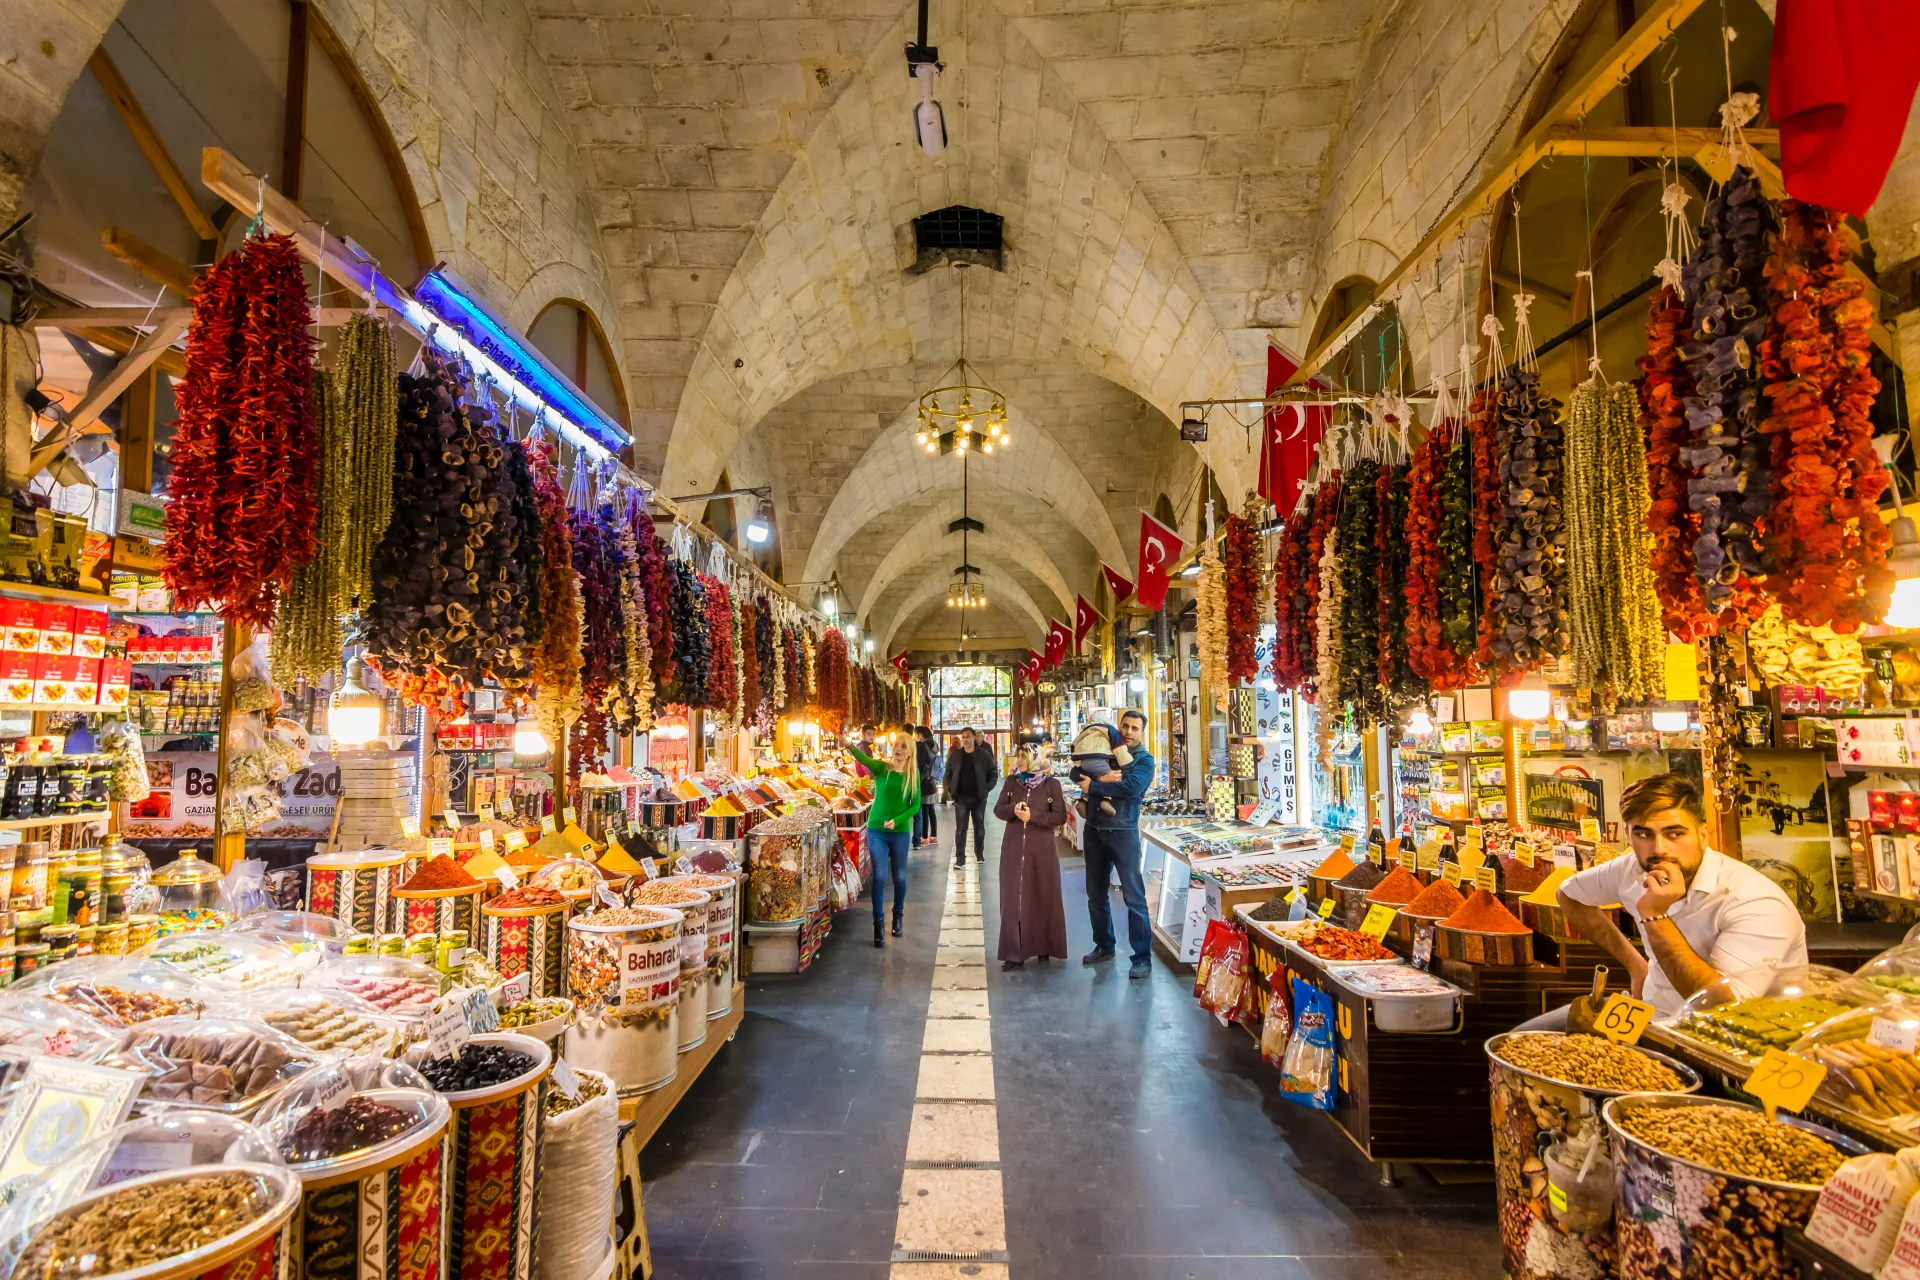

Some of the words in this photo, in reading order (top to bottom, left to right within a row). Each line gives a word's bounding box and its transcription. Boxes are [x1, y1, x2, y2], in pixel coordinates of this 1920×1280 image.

[480, 336, 516, 371] Baharat
[293, 766, 341, 797] Zad
[628, 945, 676, 971] Baharat
[1604, 1002, 1645, 1034] 65
[1761, 1057, 1804, 1090] 70
[1829, 1176, 1883, 1213] OMBUL
